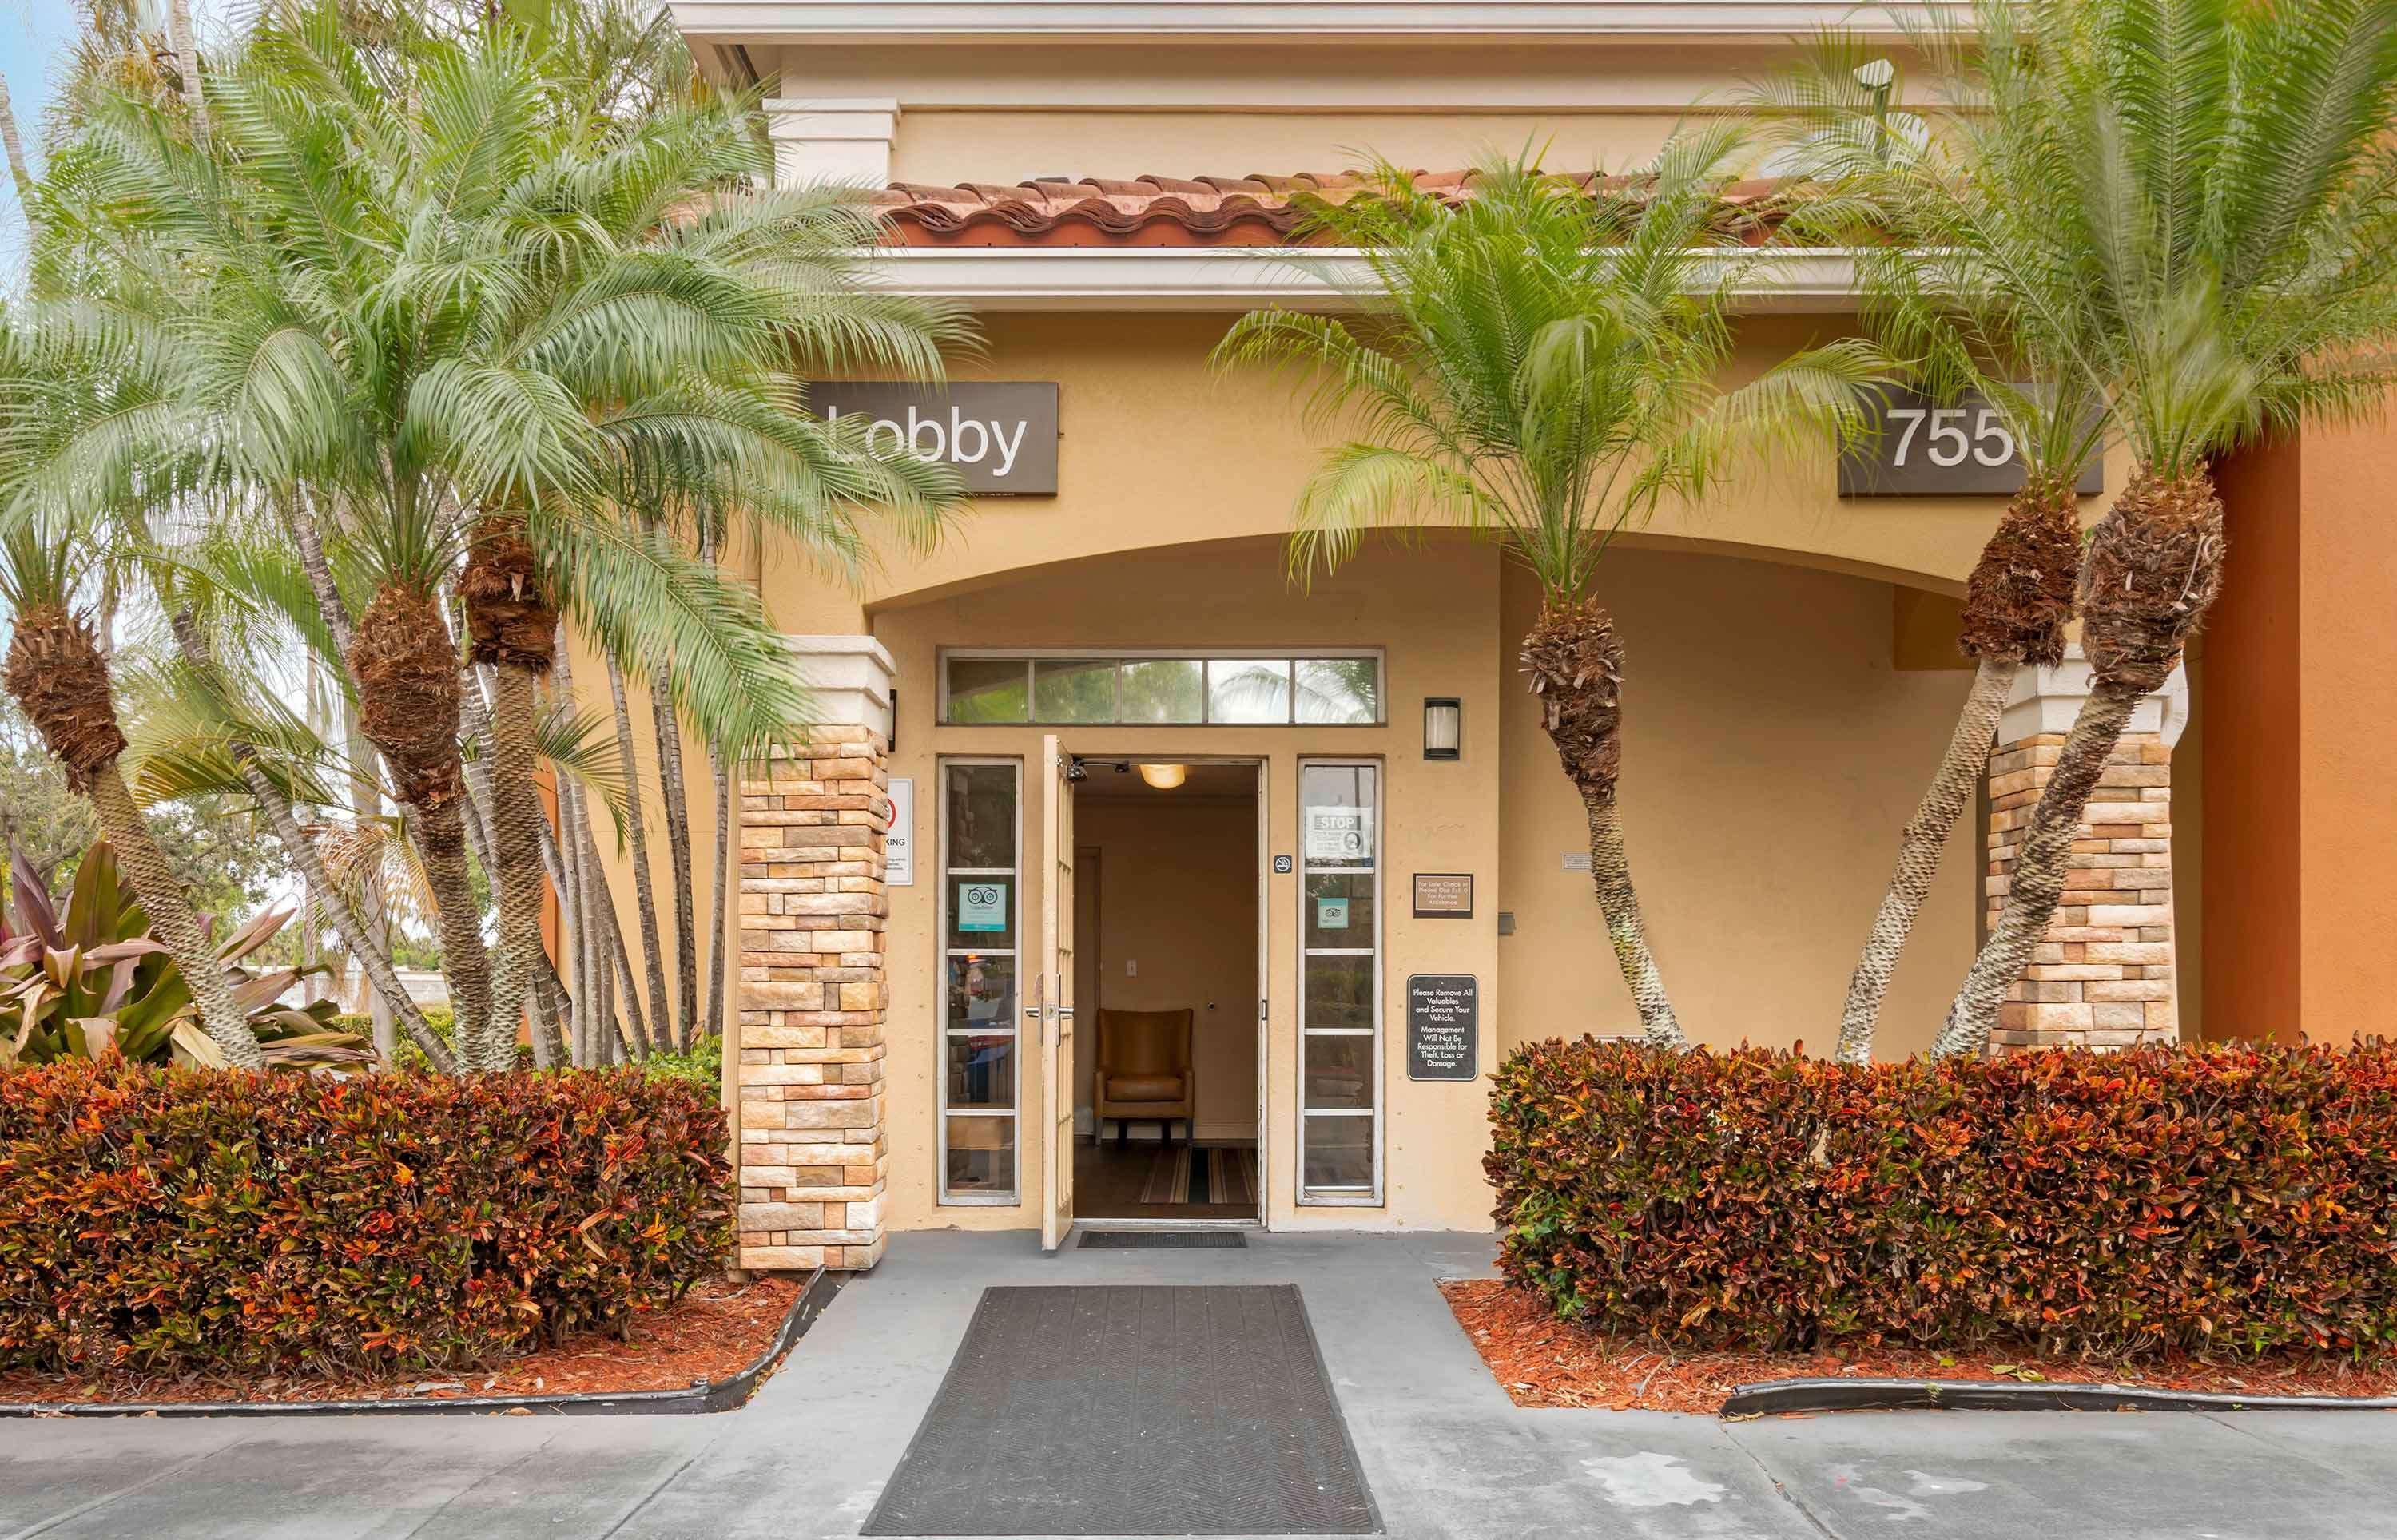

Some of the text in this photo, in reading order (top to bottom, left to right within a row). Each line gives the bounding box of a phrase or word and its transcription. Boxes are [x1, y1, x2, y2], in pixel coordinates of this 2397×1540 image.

[829, 405, 1028, 476] Lobby
[1886, 408, 2056, 467] 755
[1321, 816, 1355, 829] STOP
[1417, 1042, 1457, 1051] Responsible
[1421, 1050, 1439, 1059] Theft,
[1427, 1060, 1457, 1069] Damage.
